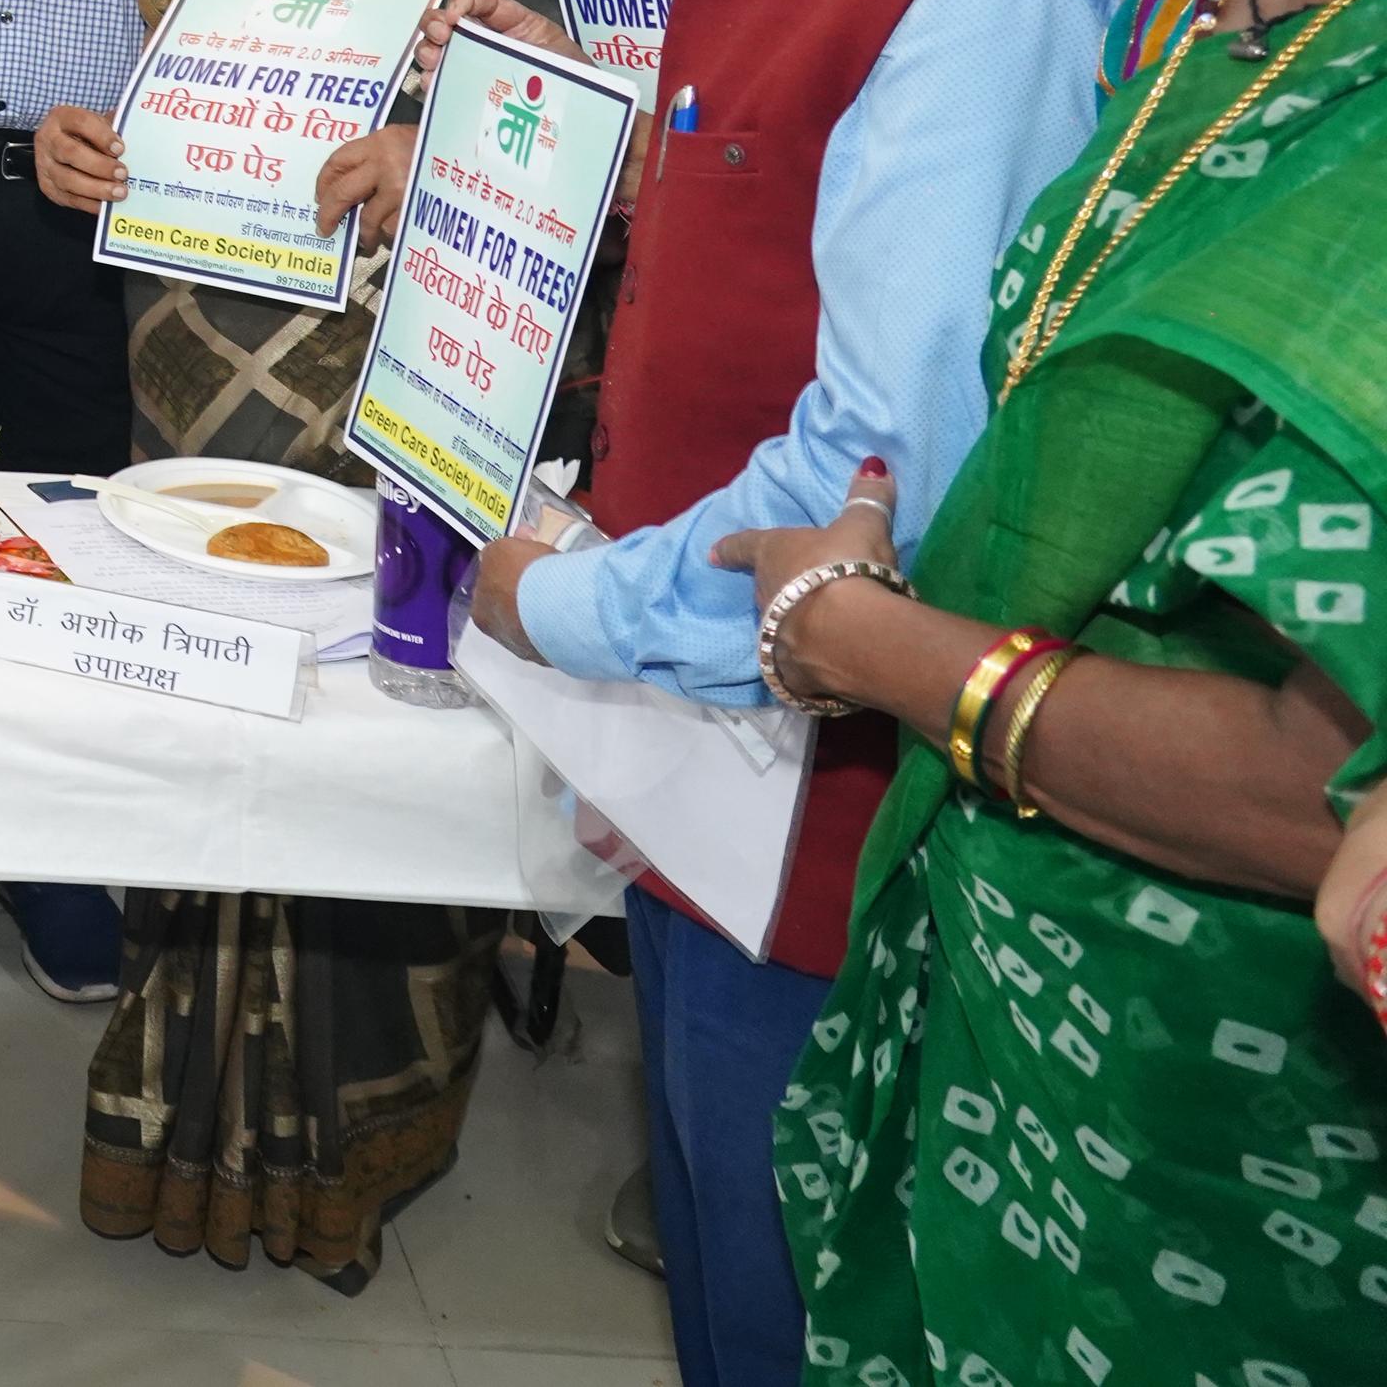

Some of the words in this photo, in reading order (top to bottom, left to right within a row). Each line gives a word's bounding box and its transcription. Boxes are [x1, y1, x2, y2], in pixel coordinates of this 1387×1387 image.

[154, 49, 248, 88] WOMEN
[246, 65, 301, 96] FOR
[304, 72, 386, 108] TREES
[140, 86, 259, 128] महिलाओं
[263, 100, 297, 133] के
[300, 107, 360, 147] लिए
[113, 217, 163, 242] Green
[169, 229, 209, 251] Care
[214, 237, 282, 268] Society
[287, 252, 334, 276] India
[414, 187, 479, 257] WOMEN
[477, 225, 517, 279] FOR
[517, 246, 576, 314] TREES
[403, 247, 486, 318] महिलाओं
[486, 284, 511, 330] के
[510, 303, 552, 365] लिए
[7, 597, 42, 627] डॉ.
[61, 611, 147, 644] अशोक
[163, 623, 253, 665] त्रिपाठी
[73, 652, 181, 691] उपाध्यक्ष
